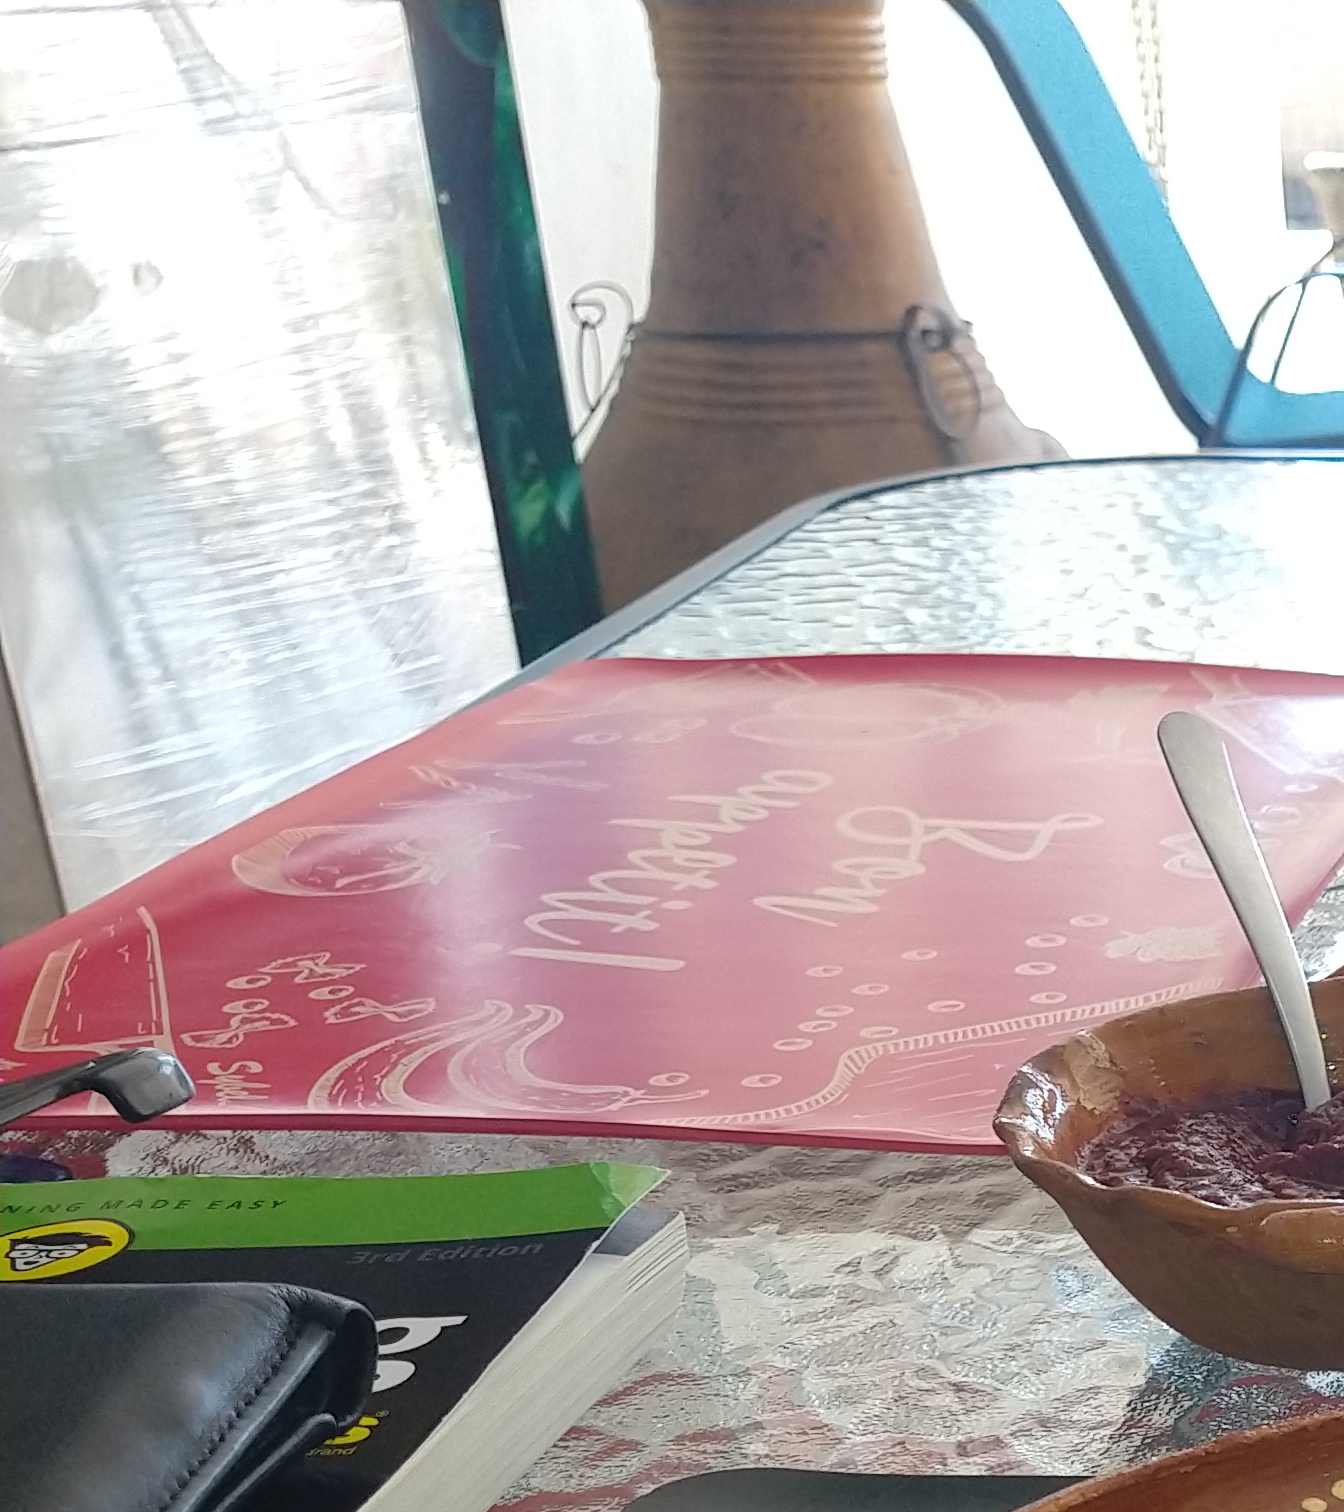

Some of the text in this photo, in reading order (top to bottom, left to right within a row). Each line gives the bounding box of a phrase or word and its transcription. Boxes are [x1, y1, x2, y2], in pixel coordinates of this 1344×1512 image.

[100, 1199, 191, 1211] MADE
[207, 1199, 287, 1212] EASY
[347, 1242, 544, 1265] 3rd Edition
